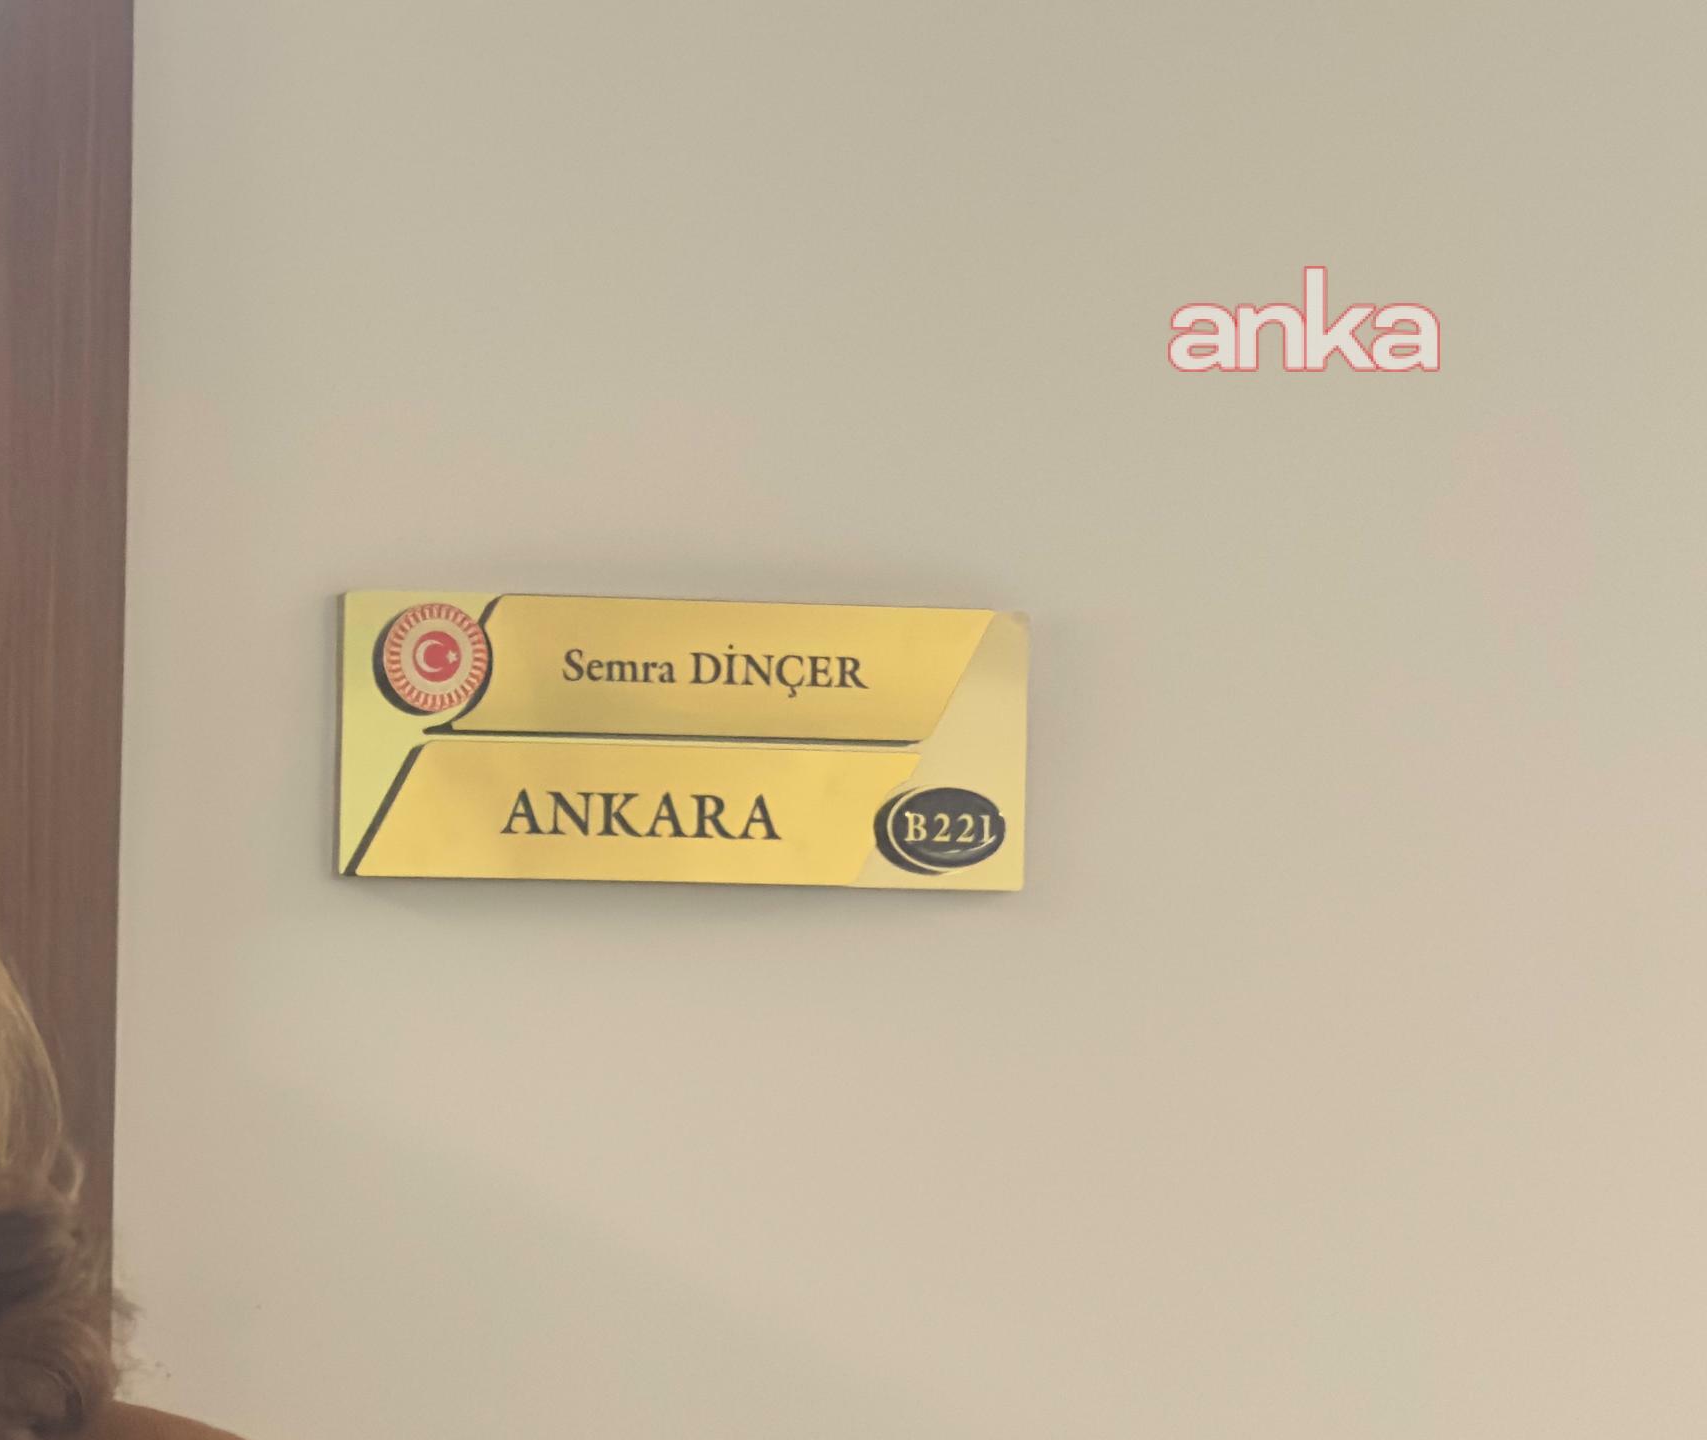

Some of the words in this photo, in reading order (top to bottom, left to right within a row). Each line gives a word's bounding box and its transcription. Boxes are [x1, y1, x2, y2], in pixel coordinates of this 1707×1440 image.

[562, 648, 676, 684] Semra
[690, 644, 868, 698] DİNÇER
[500, 788, 781, 840] ANKARA
[904, 811, 992, 844] B221
